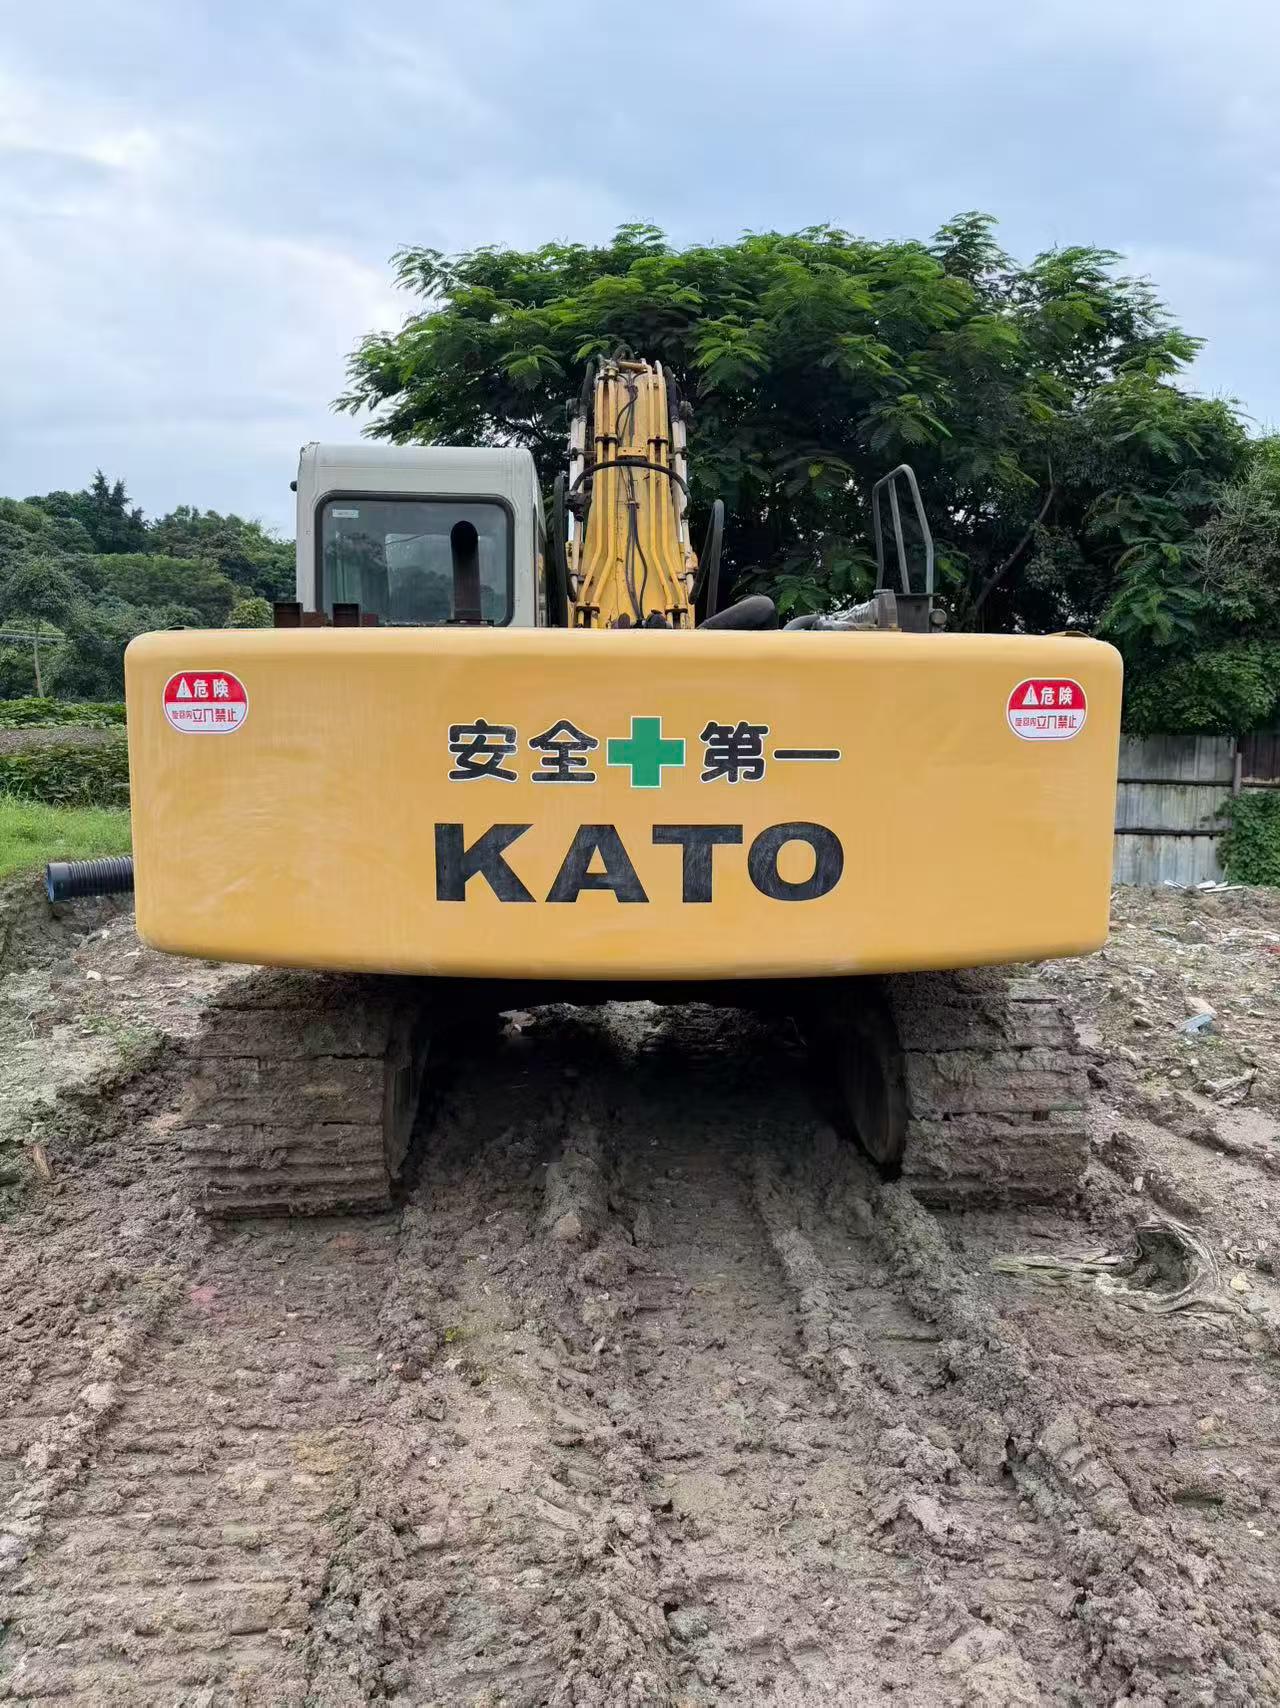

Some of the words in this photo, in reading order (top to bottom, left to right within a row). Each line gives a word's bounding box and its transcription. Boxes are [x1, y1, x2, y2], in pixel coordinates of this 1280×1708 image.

[448, 717, 599, 783] 安全
[699, 720, 841, 784] 第一
[434, 821, 844, 903] KATO
